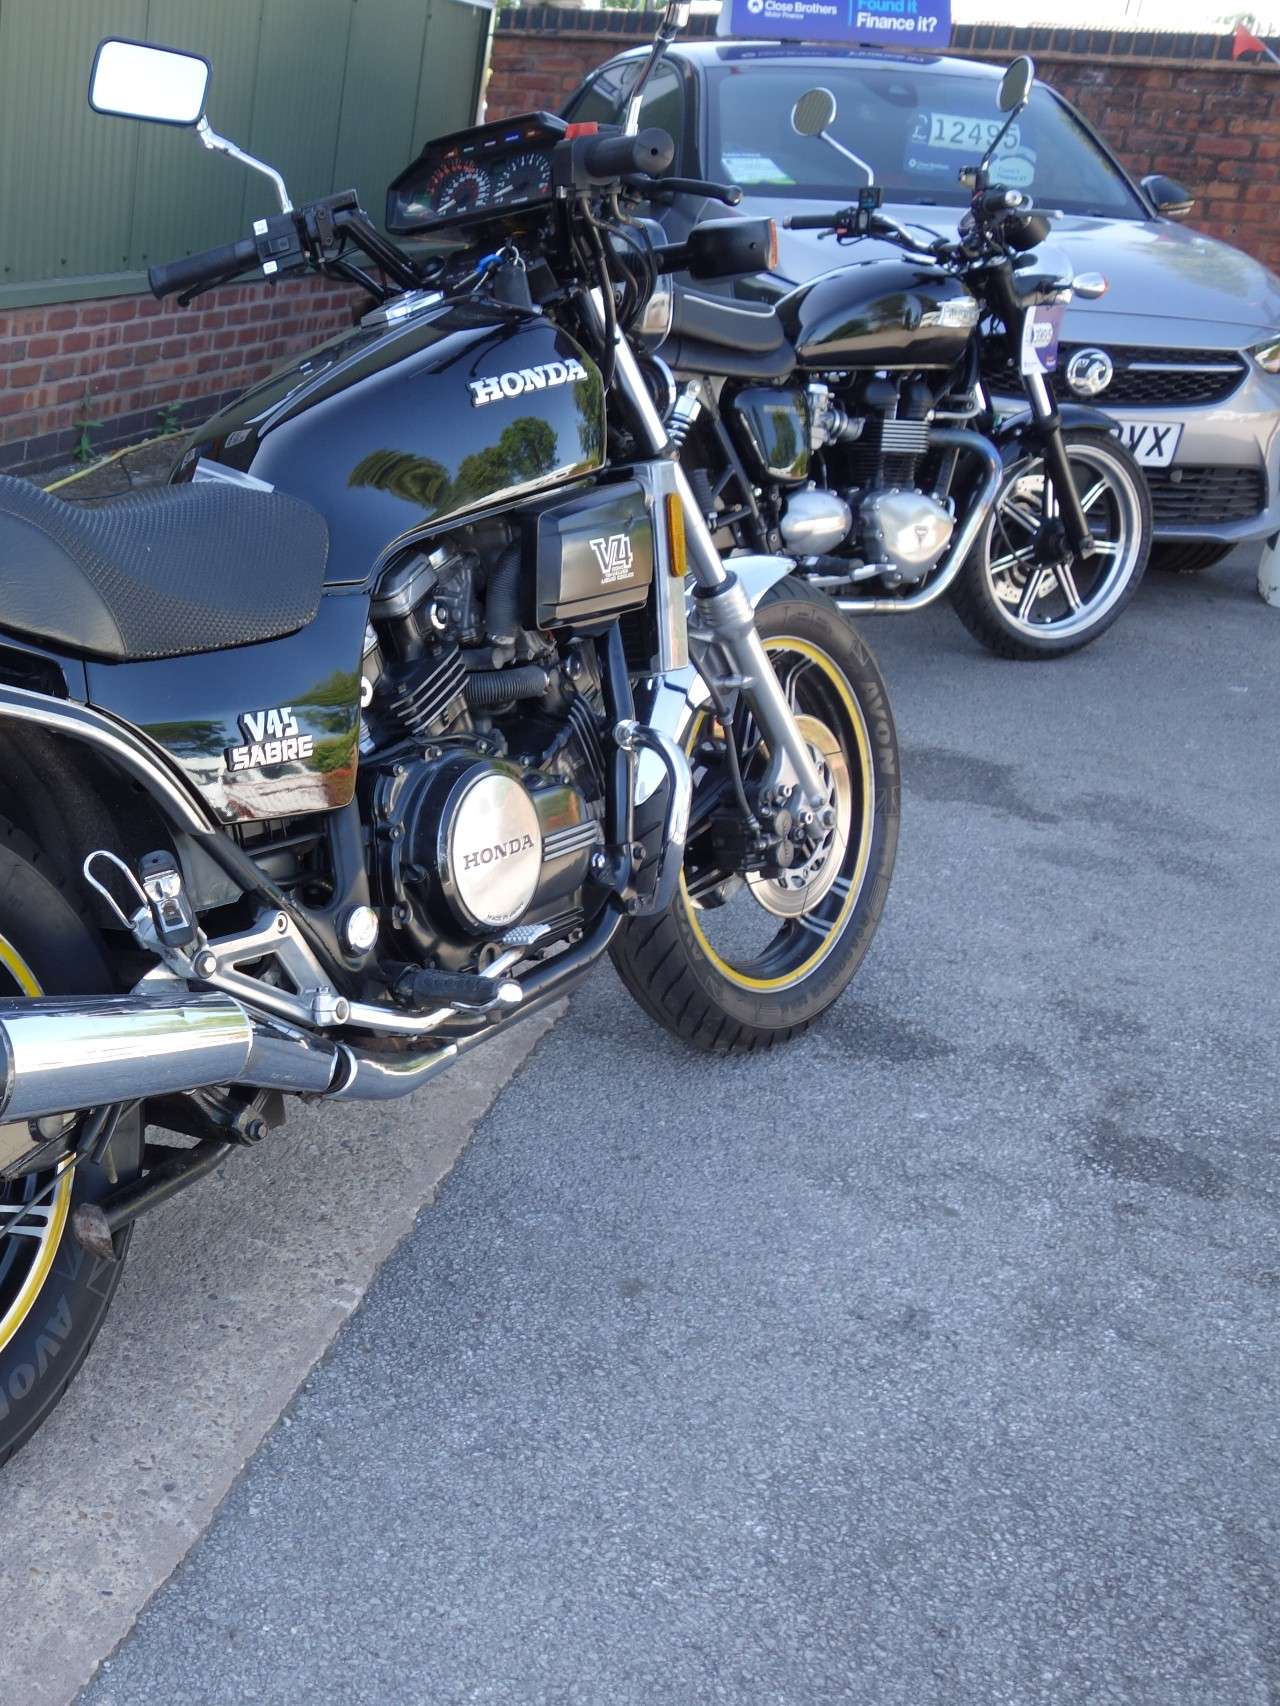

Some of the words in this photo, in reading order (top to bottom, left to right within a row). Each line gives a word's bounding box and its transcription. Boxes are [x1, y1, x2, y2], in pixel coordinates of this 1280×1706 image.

[764, 0, 793, 12] Close
[795, 1, 838, 16] Brothers
[856, 12, 915, 32] Finance
[917, 16, 938, 33] it?
[470, 358, 588, 407] HONDA
[589, 533, 634, 574] V4
[243, 706, 299, 742] V45
[860, 681, 897, 776] AVON
[232, 734, 314, 771] SABRE
[463, 834, 535, 871] HONDA
